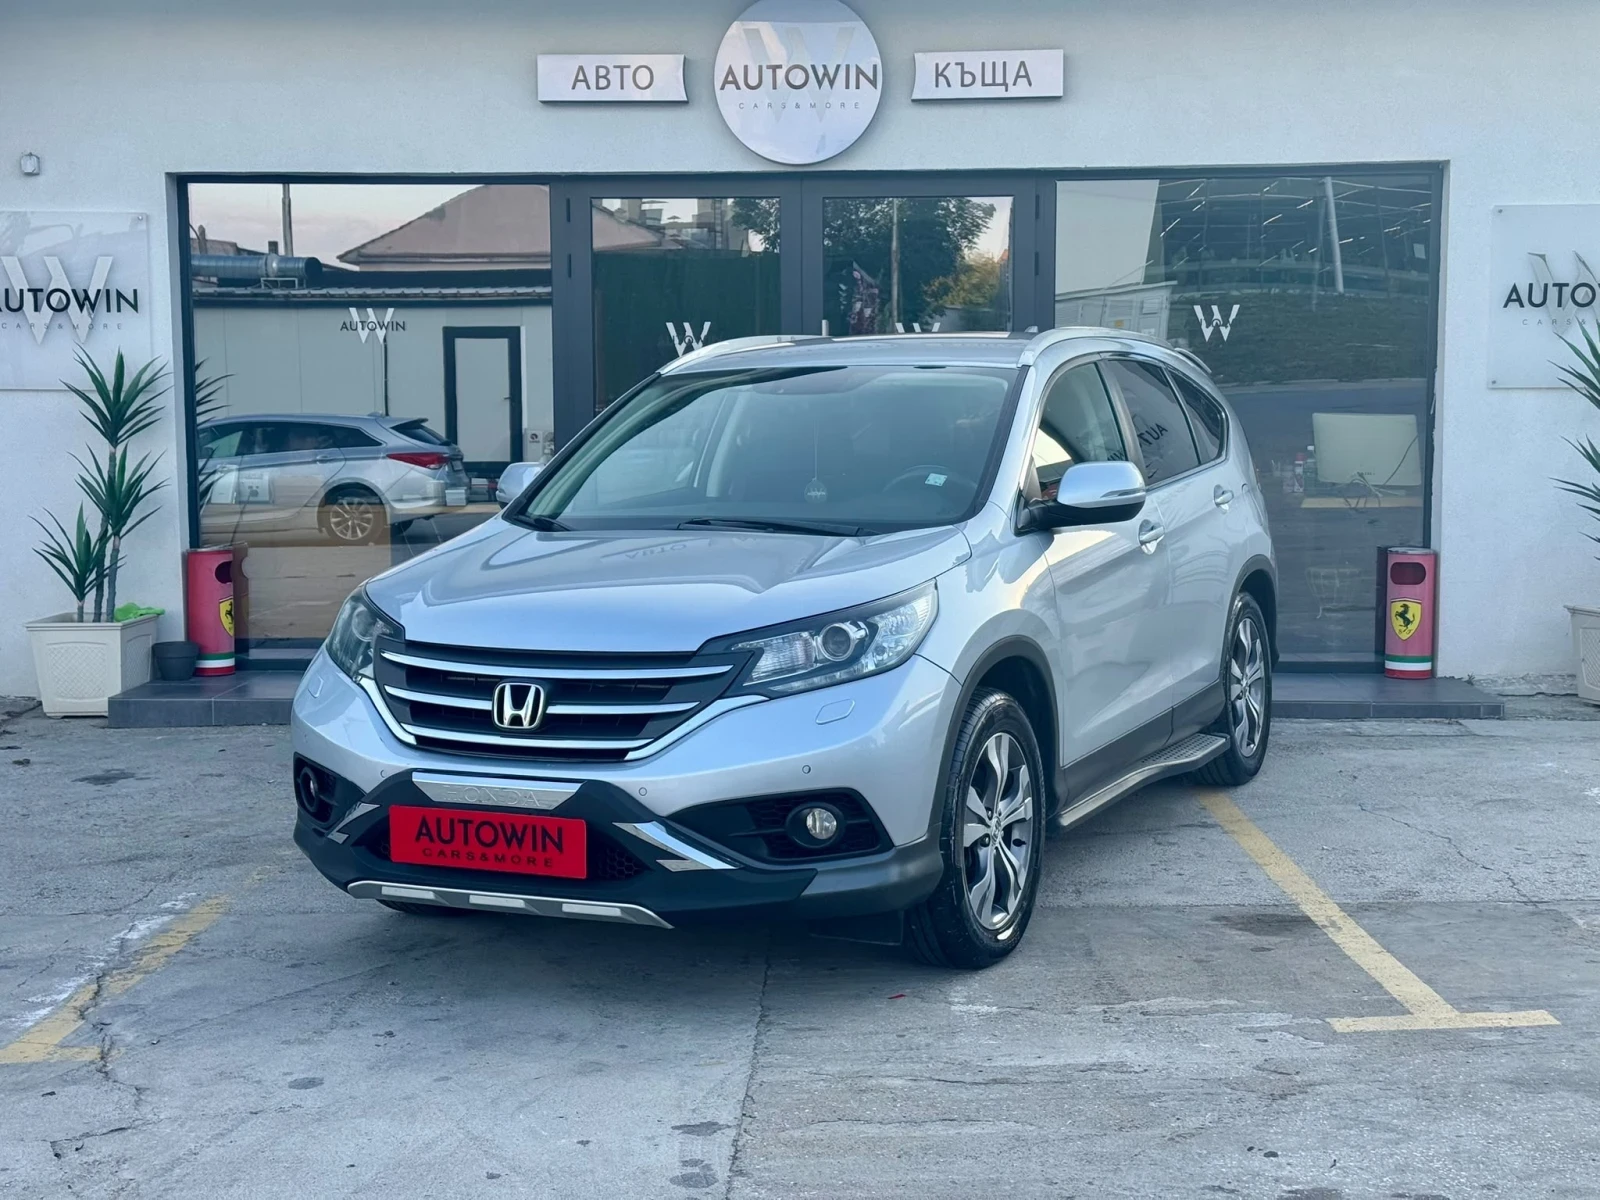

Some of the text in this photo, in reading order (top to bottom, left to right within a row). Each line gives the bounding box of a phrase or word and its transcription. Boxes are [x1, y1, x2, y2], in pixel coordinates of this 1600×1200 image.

[571, 64, 654, 90] АВТО
[719, 63, 878, 91] AUTOWIN
[934, 60, 1033, 92] КЪЩА
[0, 287, 139, 314] UTOWIN
[1502, 282, 1600, 308] AUTO
[340, 320, 406, 332] AUTOWIN
[414, 814, 564, 855] AUTOWIN
